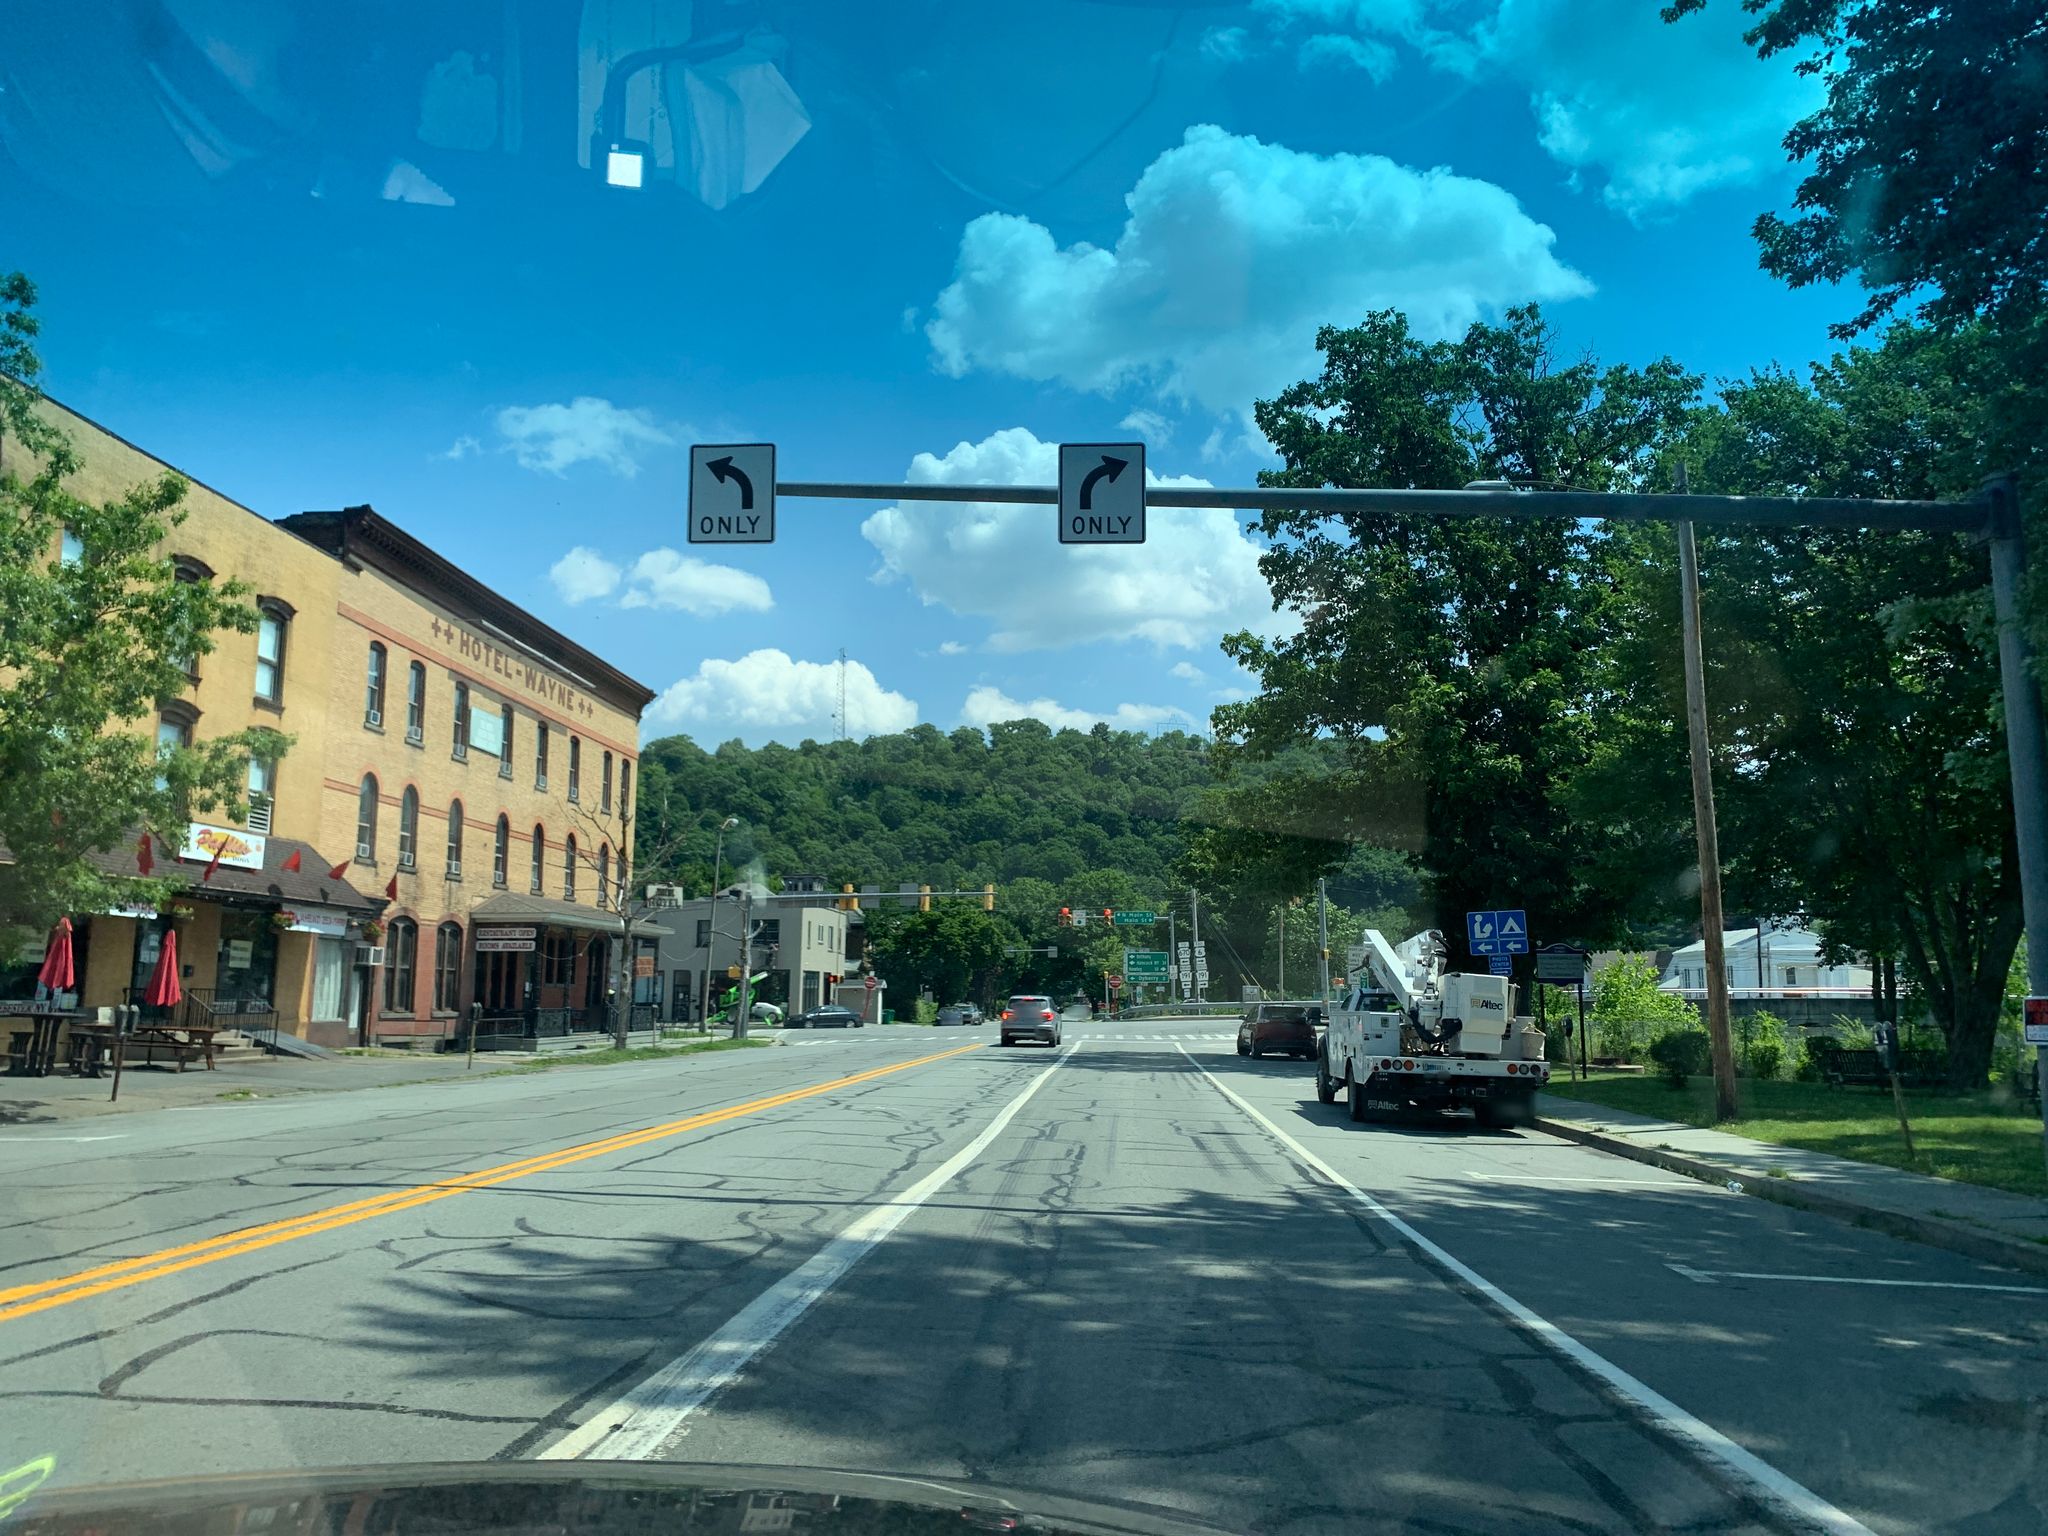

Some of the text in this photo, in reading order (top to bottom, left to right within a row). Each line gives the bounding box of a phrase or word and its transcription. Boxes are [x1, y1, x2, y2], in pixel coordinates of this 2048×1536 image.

[700, 515, 761, 535] ONLY
[1072, 515, 1132, 535] ONLY
[1480, 999, 1503, 1011] Altec
[1377, 1100, 1400, 1111] Altec
